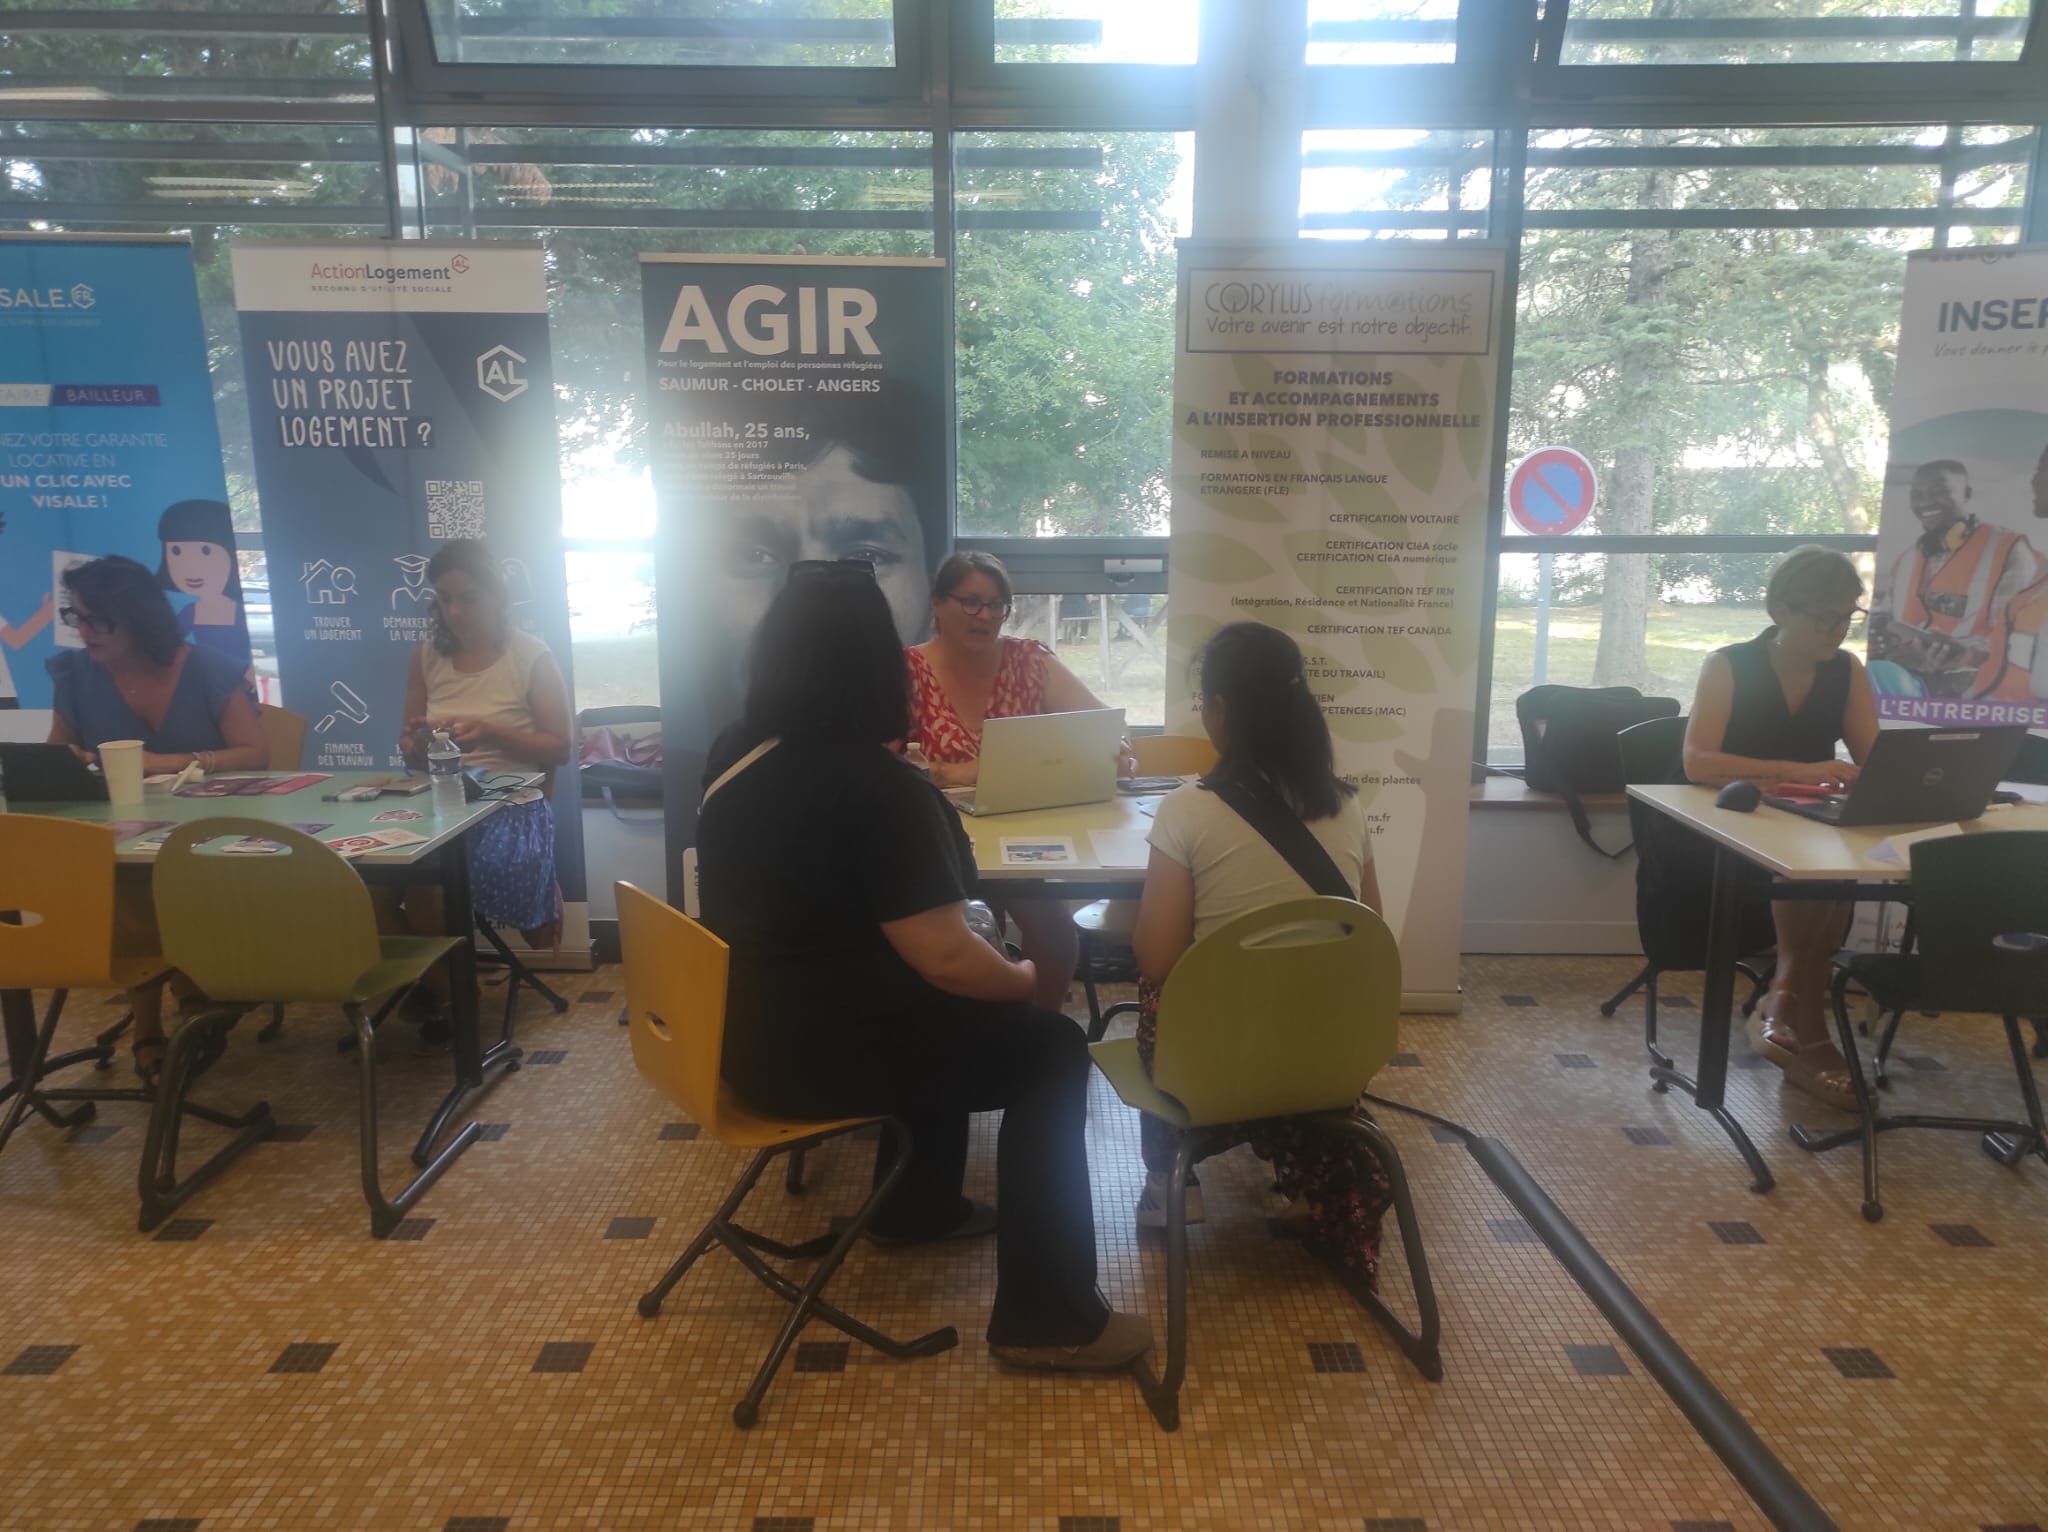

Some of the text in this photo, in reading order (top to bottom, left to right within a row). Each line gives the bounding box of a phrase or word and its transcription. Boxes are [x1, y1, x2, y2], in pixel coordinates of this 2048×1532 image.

[311, 263, 452, 283] ActionLogement
[1205, 282, 1313, 314] CORYLUS
[658, 285, 881, 356] AGIR
[1207, 316, 1255, 334] Votre
[1262, 319, 1313, 334] avenir
[1318, 316, 1344, 334] est
[1351, 317, 1399, 334] notre
[268, 340, 408, 373] VOUS AVEZ
[659, 377, 729, 391] SAUMUR
[742, 378, 805, 391] CHOLET
[816, 379, 881, 392] ANGERS
[1273, 371, 1393, 386] FORMATIONS
[66, 389, 145, 402] BAILLEUR
[272, 378, 413, 411] UN PROJET
[1229, 391, 1441, 407] ET ACCOMPAGNEMENTS
[1203, 411, 1312, 426] L'INSERTION
[1316, 413, 1481, 428] PROFESSIONNELLE
[280, 416, 432, 447] LOGEMENT ?
[663, 421, 811, 441] Abullah, 25 ans,
[28, 432, 81, 448] VOTRE
[86, 432, 168, 448] GARANTIE
[746, 440, 769, 449] 2017
[8, 453, 117, 468] LOCATIVE EN
[1200, 450, 1240, 459] REMISE
[1251, 451, 1291, 460] NIVEAU
[35, 474, 79, 488] CLIC
[83, 474, 132, 488] AVEC
[1200, 473, 1388, 485] FORMATIONS EN FRANÇAIS LANGUE
[1264, 486, 1290, 496] (FLE)
[32, 495, 99, 508] VISALE
[1329, 514, 1461, 524] CERTIFICATION VOLTAIRE
[1326, 541, 1404, 550] CERTIFICATION
[1296, 553, 1375, 562] CERTIFICATION
[1402, 554, 1457, 566] numérique
[1335, 586, 1455, 596] CERTIFICATION TEF IRN
[1295, 597, 1345, 607] Résidence
[1360, 598, 1416, 608] Nationalité
[1307, 625, 1453, 635] CERTIFICATION TEF CANADA
[1322, 669, 1337, 678] DU
[1340, 669, 1386, 679] TRAVAIL)
[1321, 706, 1406, 717] PETENCES (MAC)
[1880, 699, 2047, 724] L'ENTREPRISE
[1362, 774, 1380, 784] des
[1383, 775, 1422, 787] plantes
